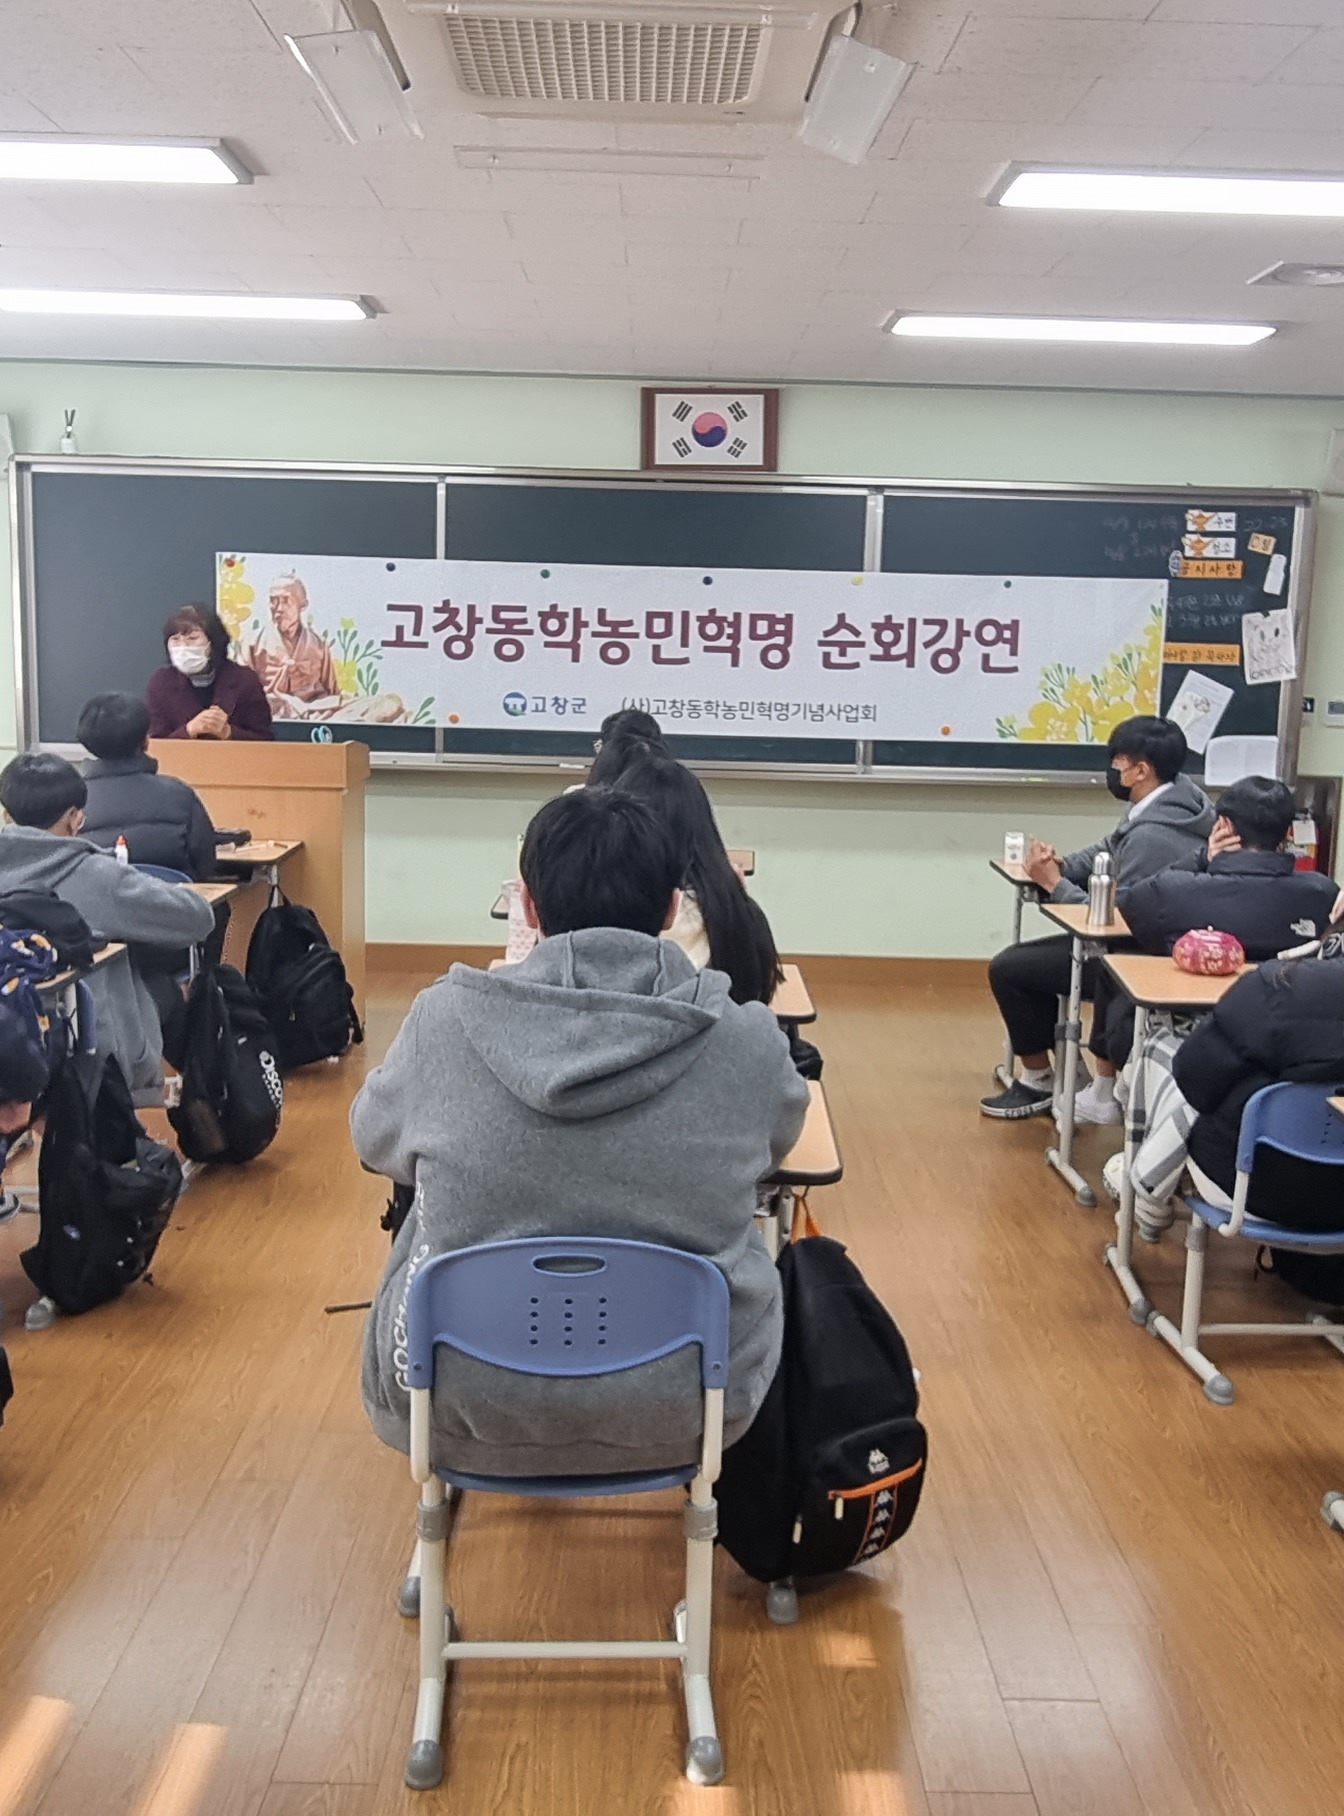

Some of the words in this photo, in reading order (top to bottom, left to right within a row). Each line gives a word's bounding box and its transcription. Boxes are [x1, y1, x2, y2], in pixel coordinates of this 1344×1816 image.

[380, 598, 794, 670] 고창동학농민혁명
[817, 612, 1020, 675] 순회강연
[530, 695, 588, 715] 고창군
[620, 696, 878, 723] (사)고창동학농민혁명기념사업회
